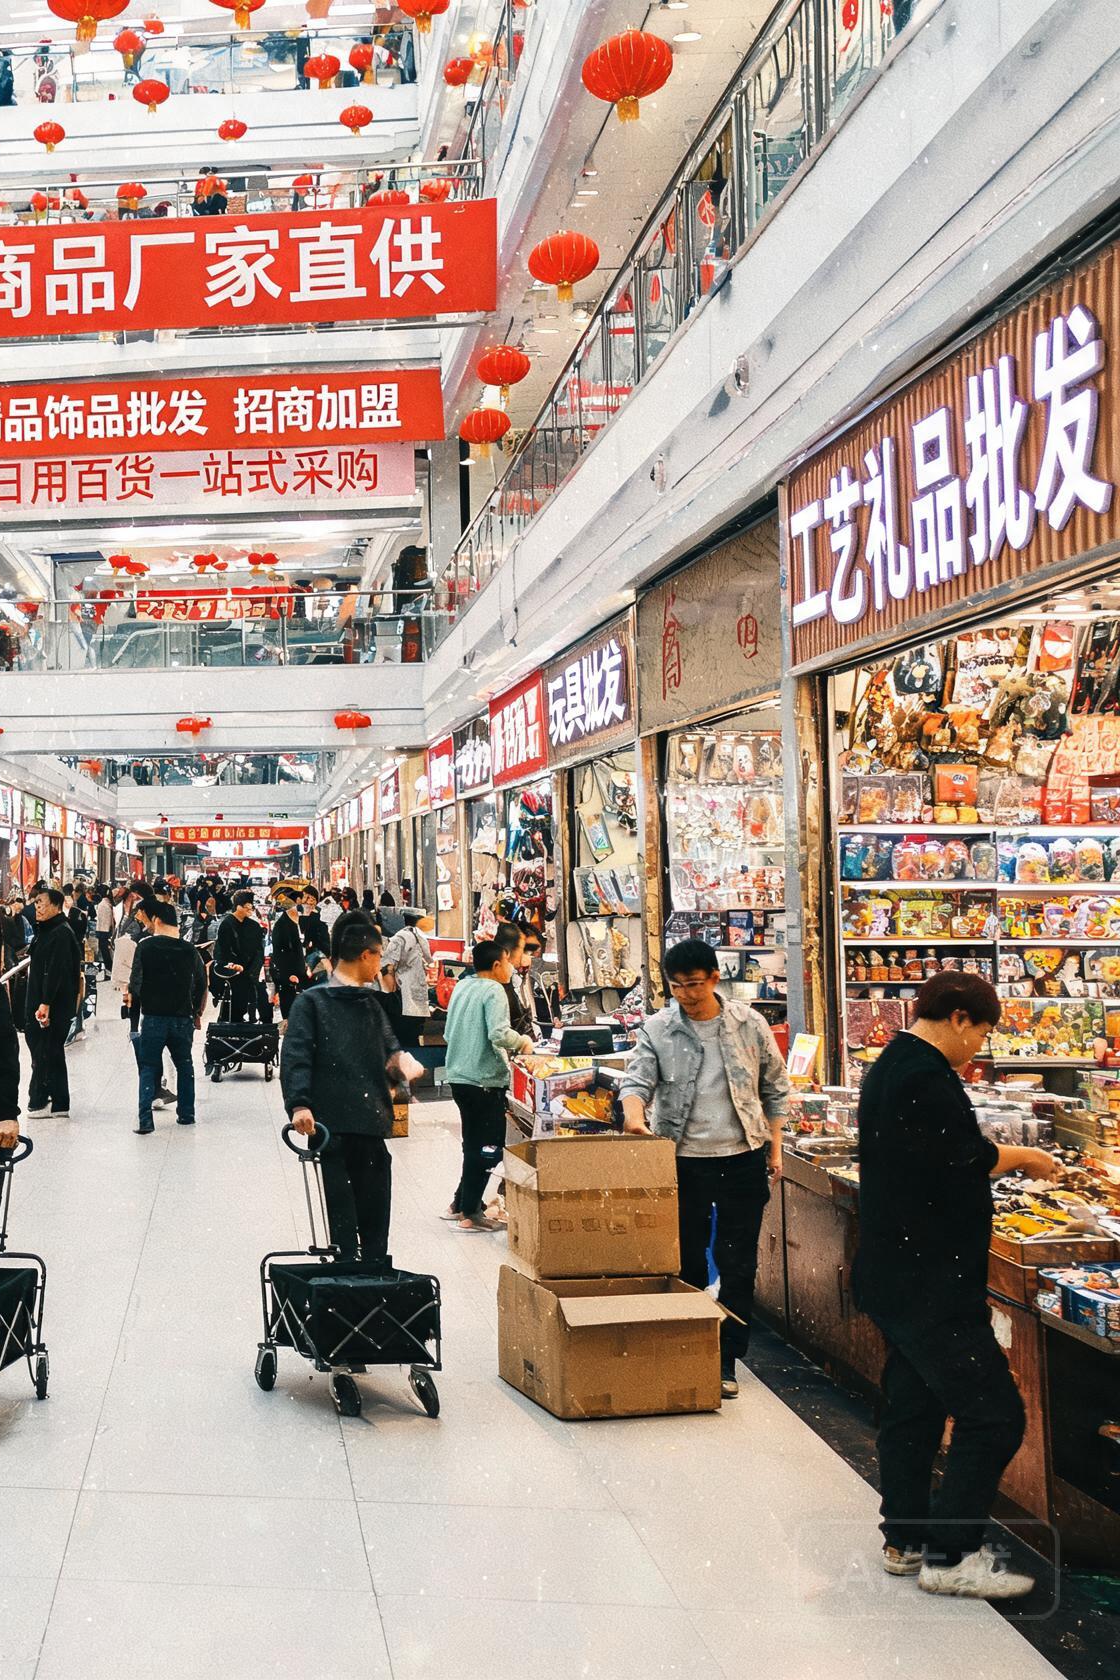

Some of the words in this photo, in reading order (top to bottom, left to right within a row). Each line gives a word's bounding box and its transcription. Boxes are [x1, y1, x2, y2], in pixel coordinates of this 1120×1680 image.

[233, 383, 402, 434] 招商加盟
[790, 304, 1104, 626] 工艺礼品批发
